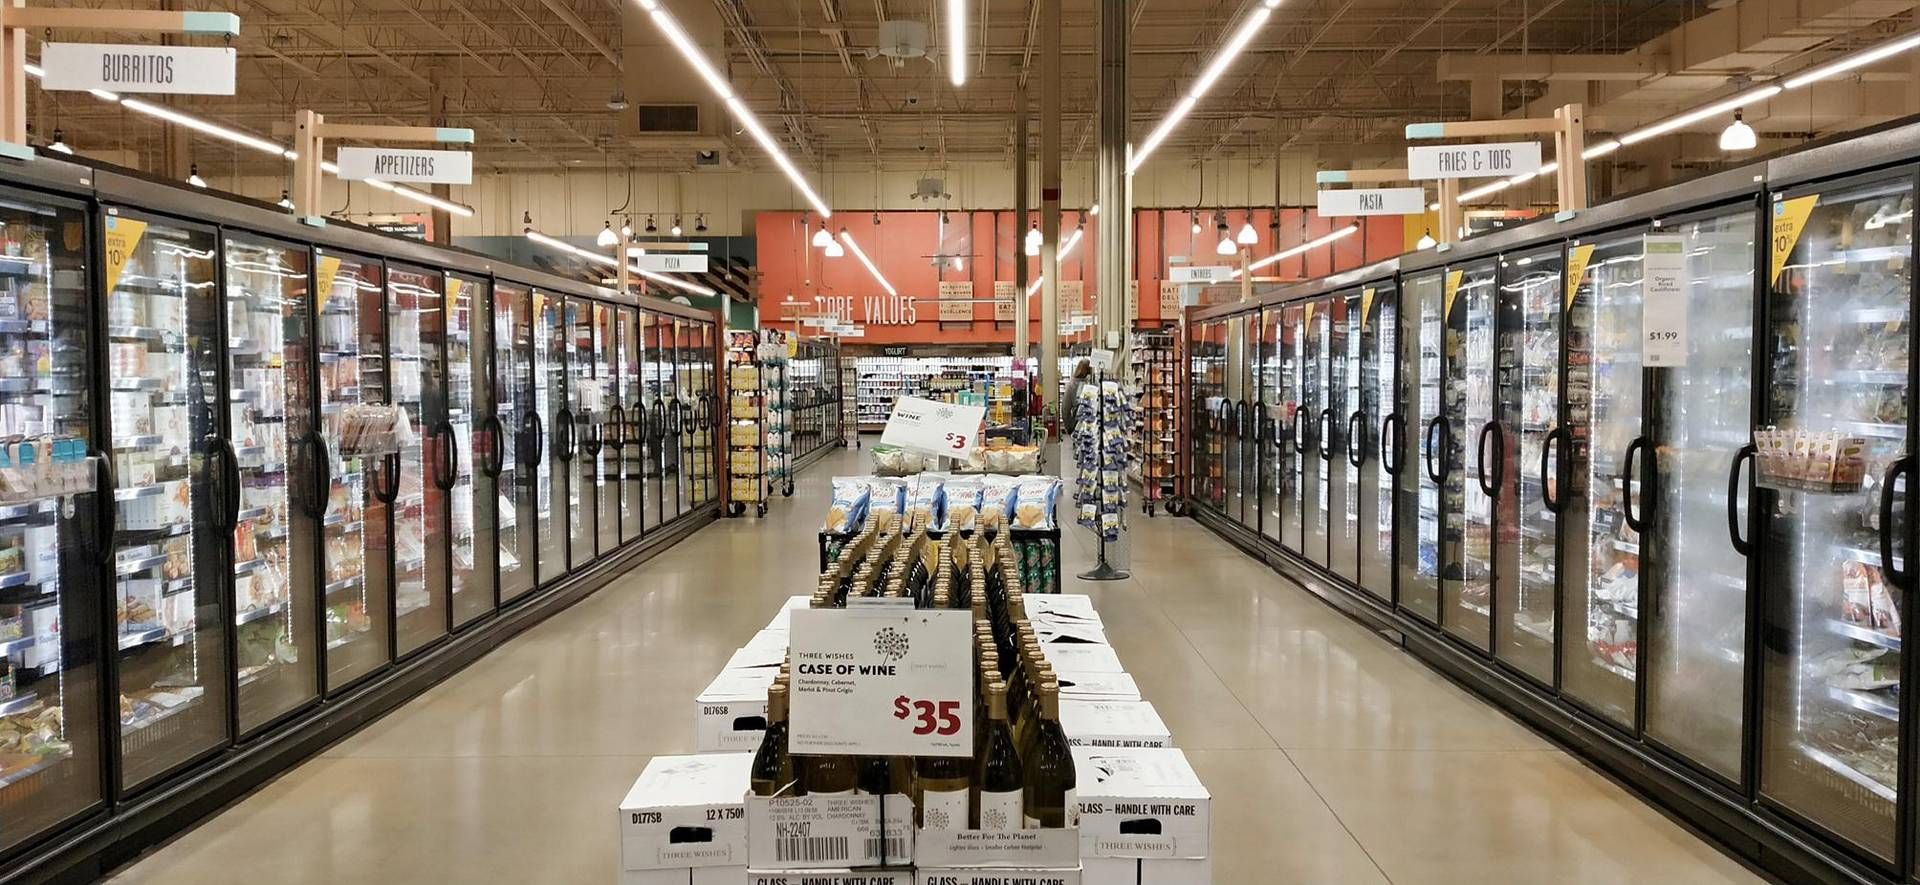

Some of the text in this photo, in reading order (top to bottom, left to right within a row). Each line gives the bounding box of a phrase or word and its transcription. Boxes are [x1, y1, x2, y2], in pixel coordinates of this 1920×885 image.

[102, 53, 174, 84] BURRITOS
[375, 154, 434, 176] APPETIZERS
[1439, 149, 1512, 171] FRIES & TOTS
[1359, 194, 1383, 210] PASTA
[1774, 222, 1793, 233] extra
[665, 256, 681, 269] PIZZA
[863, 296, 916, 325] VALUES
[1649, 332, 1678, 340] $1.99
[884, 347, 906, 355] YOGURT
[897, 411, 921, 421] WINE
[799, 652, 822, 660] THREE
[798, 663, 896, 676] CASE OF WINE
[704, 706, 728, 715] D176SB
[893, 695, 961, 736] $35
[1123, 740, 1142, 748] WITH
[1115, 803, 1148, 815] HANDLE
[1151, 804, 1171, 815] WITH
[1174, 804, 1196, 816] CARE
[632, 812, 662, 824] D177SB
[706, 809, 716, 820] 12
[776, 821, 810, 837] NH-22407
[1101, 842, 1172, 851] THREE WISHES
[663, 849, 727, 860] THREE WISHES
